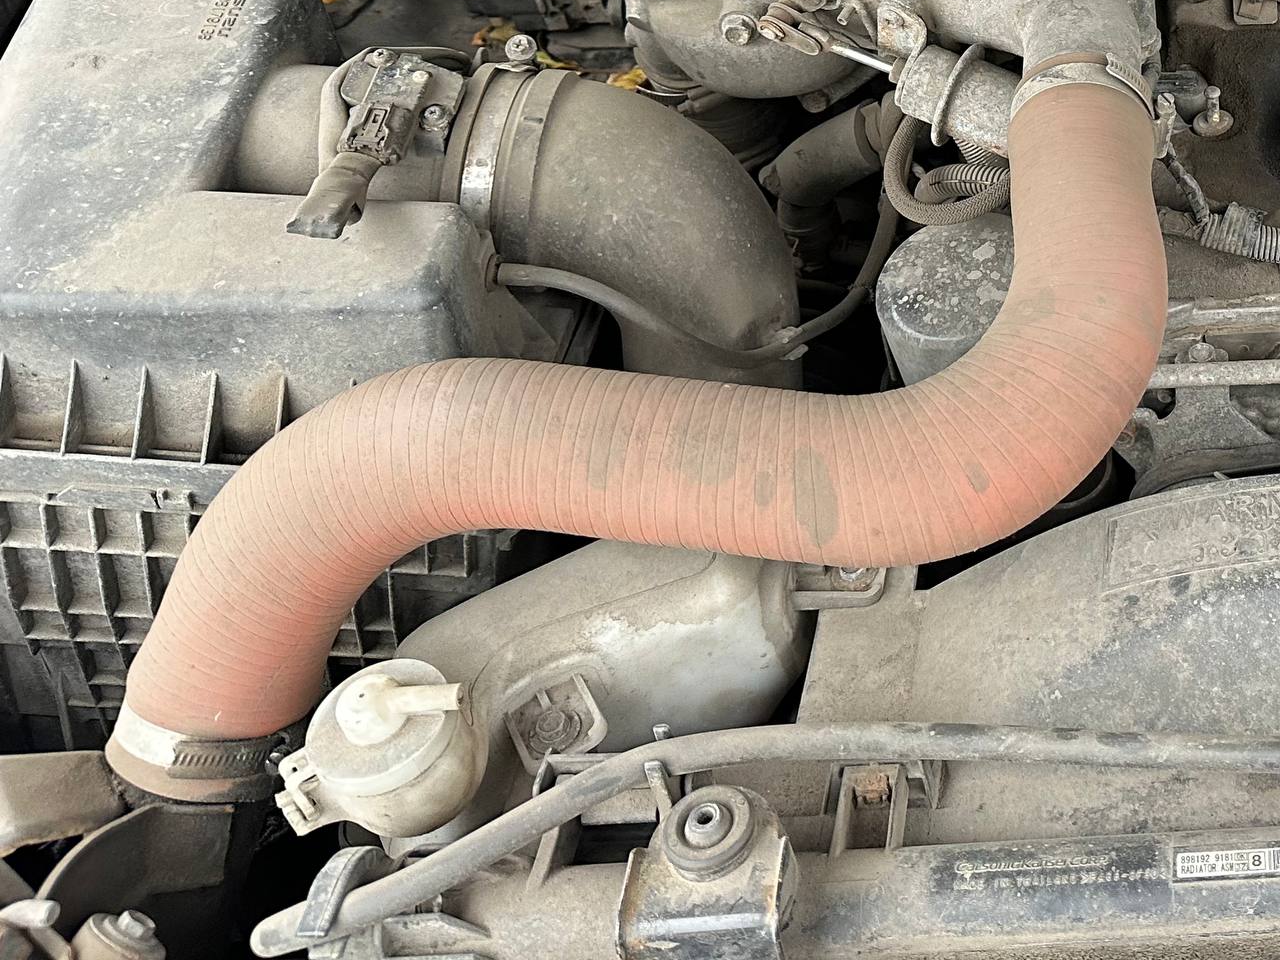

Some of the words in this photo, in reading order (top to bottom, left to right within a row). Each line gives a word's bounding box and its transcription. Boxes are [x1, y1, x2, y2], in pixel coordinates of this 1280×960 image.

[1181, 854, 1210, 864] 898192
[1252, 855, 1262, 867] 8
[1181, 863, 1217, 874] RADIATOR
[1221, 862, 1234, 872] ASM
